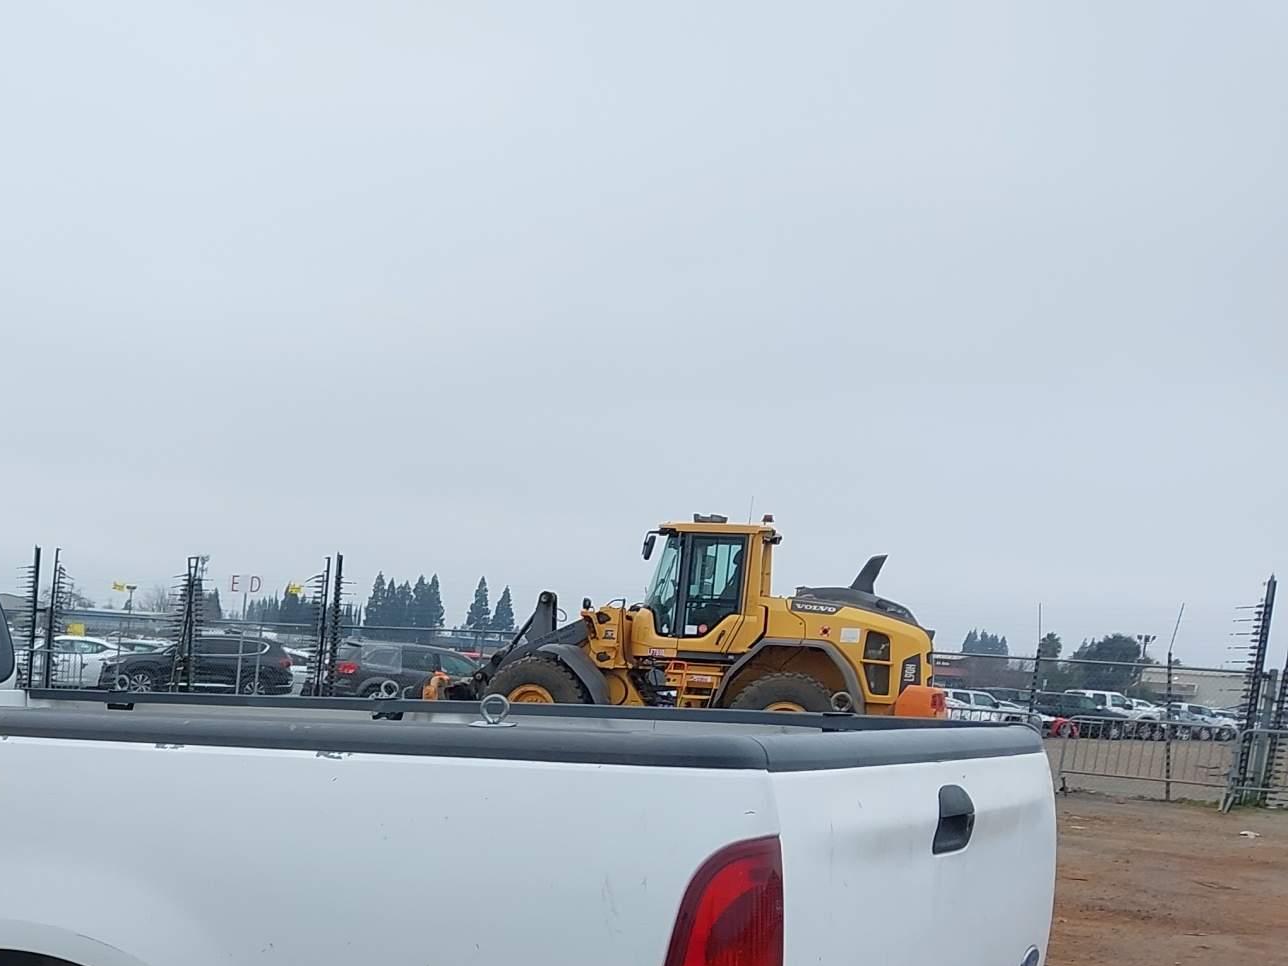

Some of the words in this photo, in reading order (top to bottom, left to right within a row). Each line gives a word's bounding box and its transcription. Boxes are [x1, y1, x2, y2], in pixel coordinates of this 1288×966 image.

[231, 574, 241, 592] E
[249, 575, 262, 593] D
[795, 603, 837, 613] VOLVO
